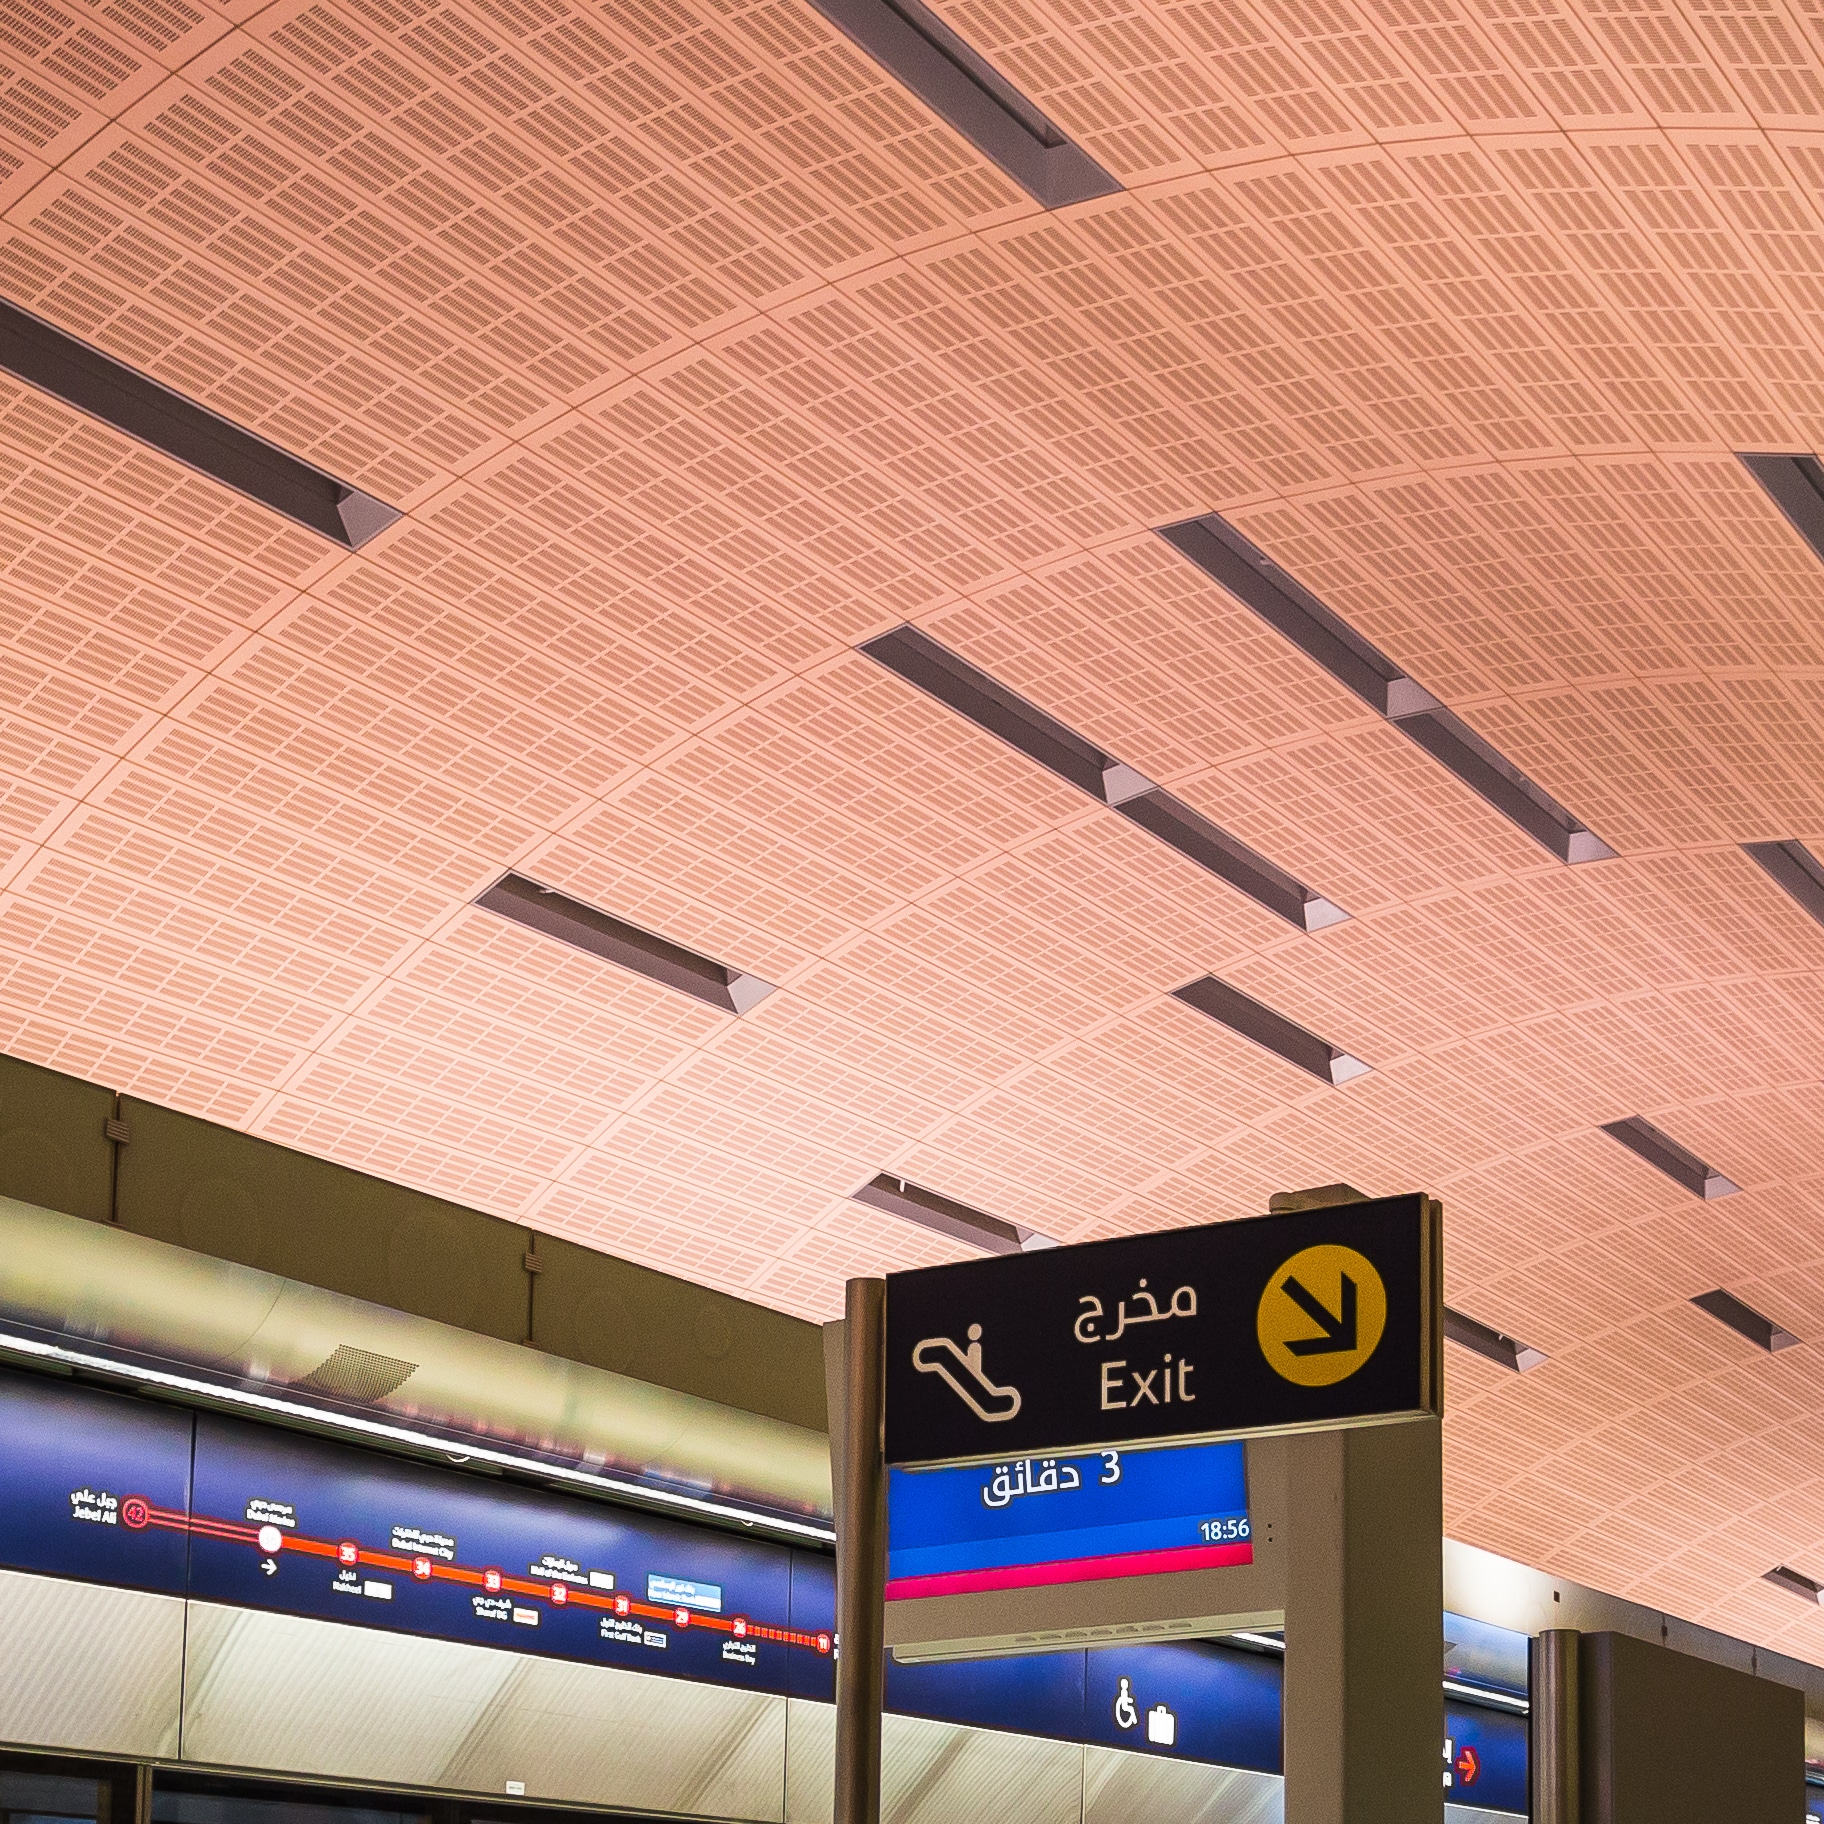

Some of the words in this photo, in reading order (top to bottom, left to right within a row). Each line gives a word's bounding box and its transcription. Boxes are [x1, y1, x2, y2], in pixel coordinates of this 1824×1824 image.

[1073, 1277, 1199, 1344] مخرج
[1100, 1353, 1197, 1411] Exit
[1099, 1450, 1122, 1485] 3
[982, 1458, 1081, 1508] دقائق
[72, 1506, 102, 1521] Jebel
[1199, 1517, 1251, 1542] 18:56
[342, 1546, 356, 1562] 35
[415, 1561, 431, 1576] 34
